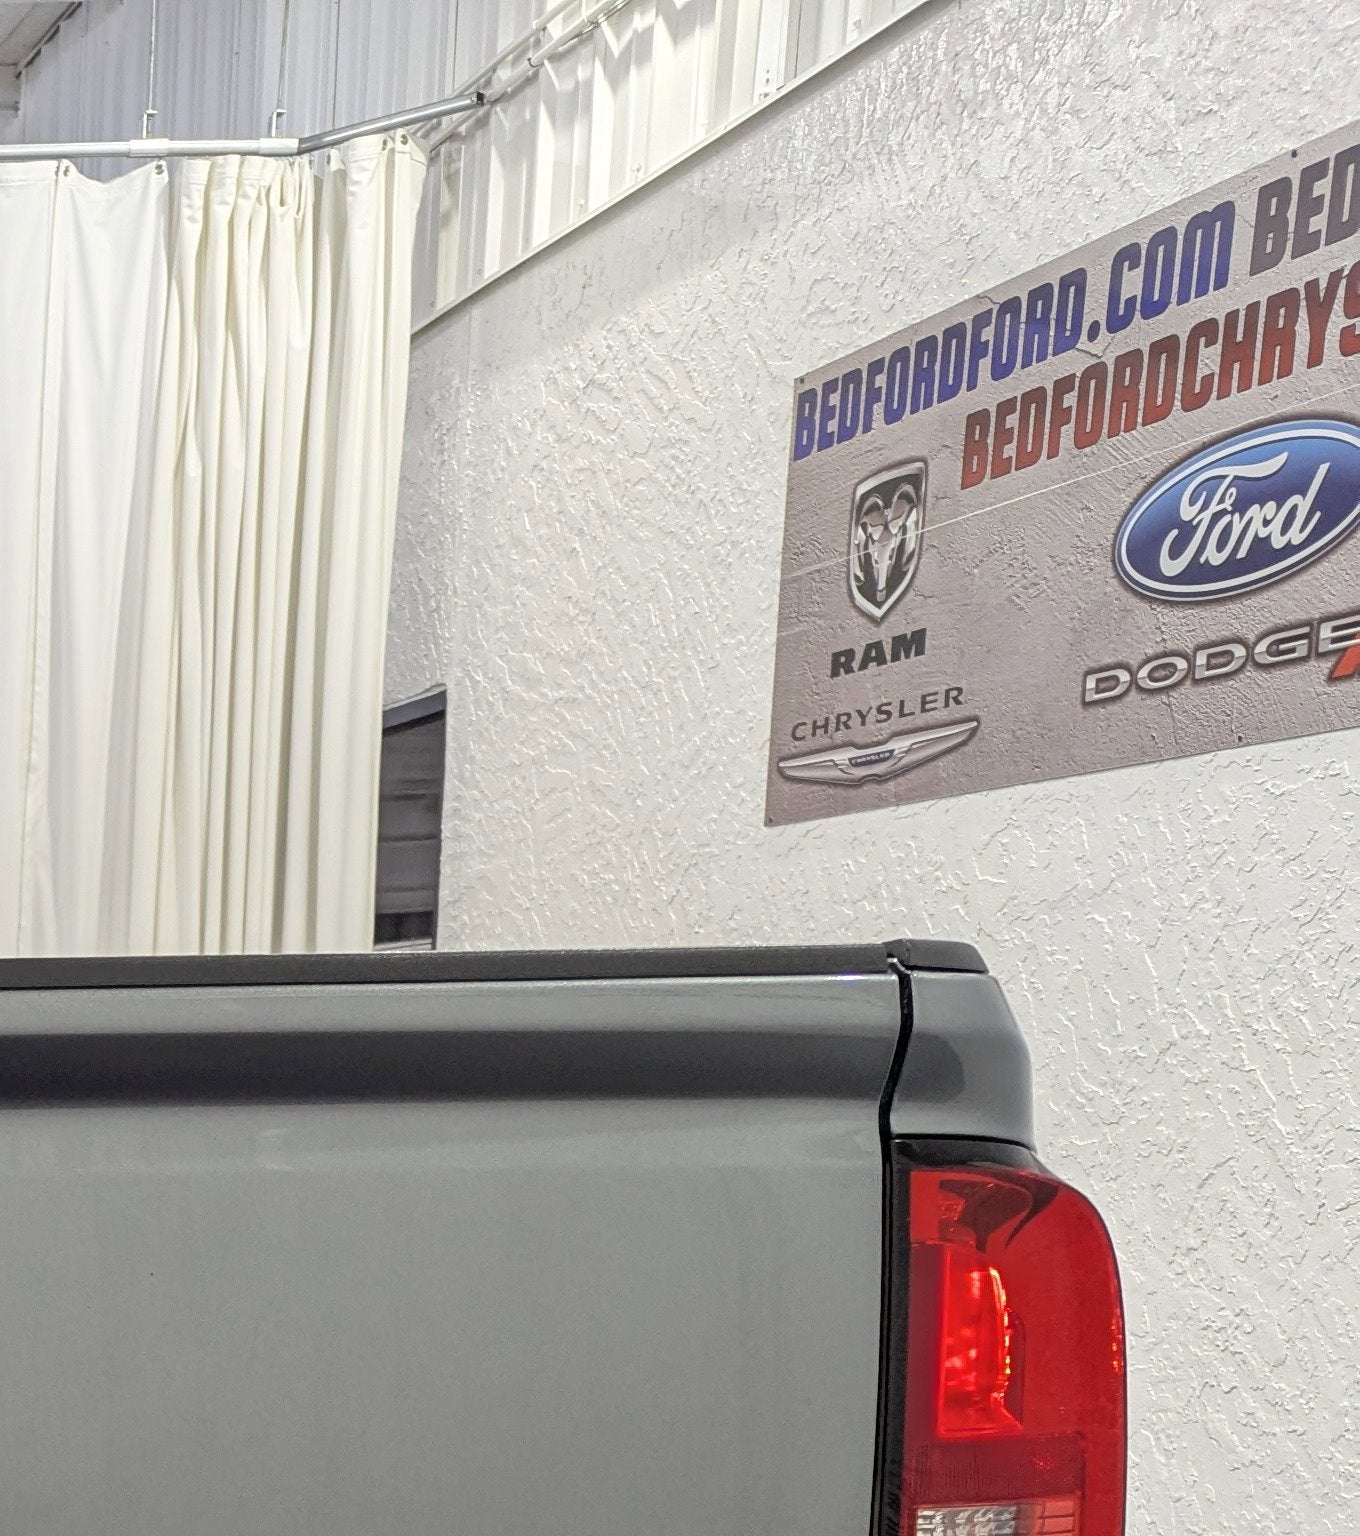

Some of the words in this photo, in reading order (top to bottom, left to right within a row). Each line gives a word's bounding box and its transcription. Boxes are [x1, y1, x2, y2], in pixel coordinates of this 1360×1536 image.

[792, 200, 1236, 462] BEDFORDFORD.COM
[1159, 451, 1331, 577] Ford
[830, 627, 927, 679] RAM
[1083, 614, 1360, 703] DODGE
[791, 686, 965, 742] CHRYSLER
